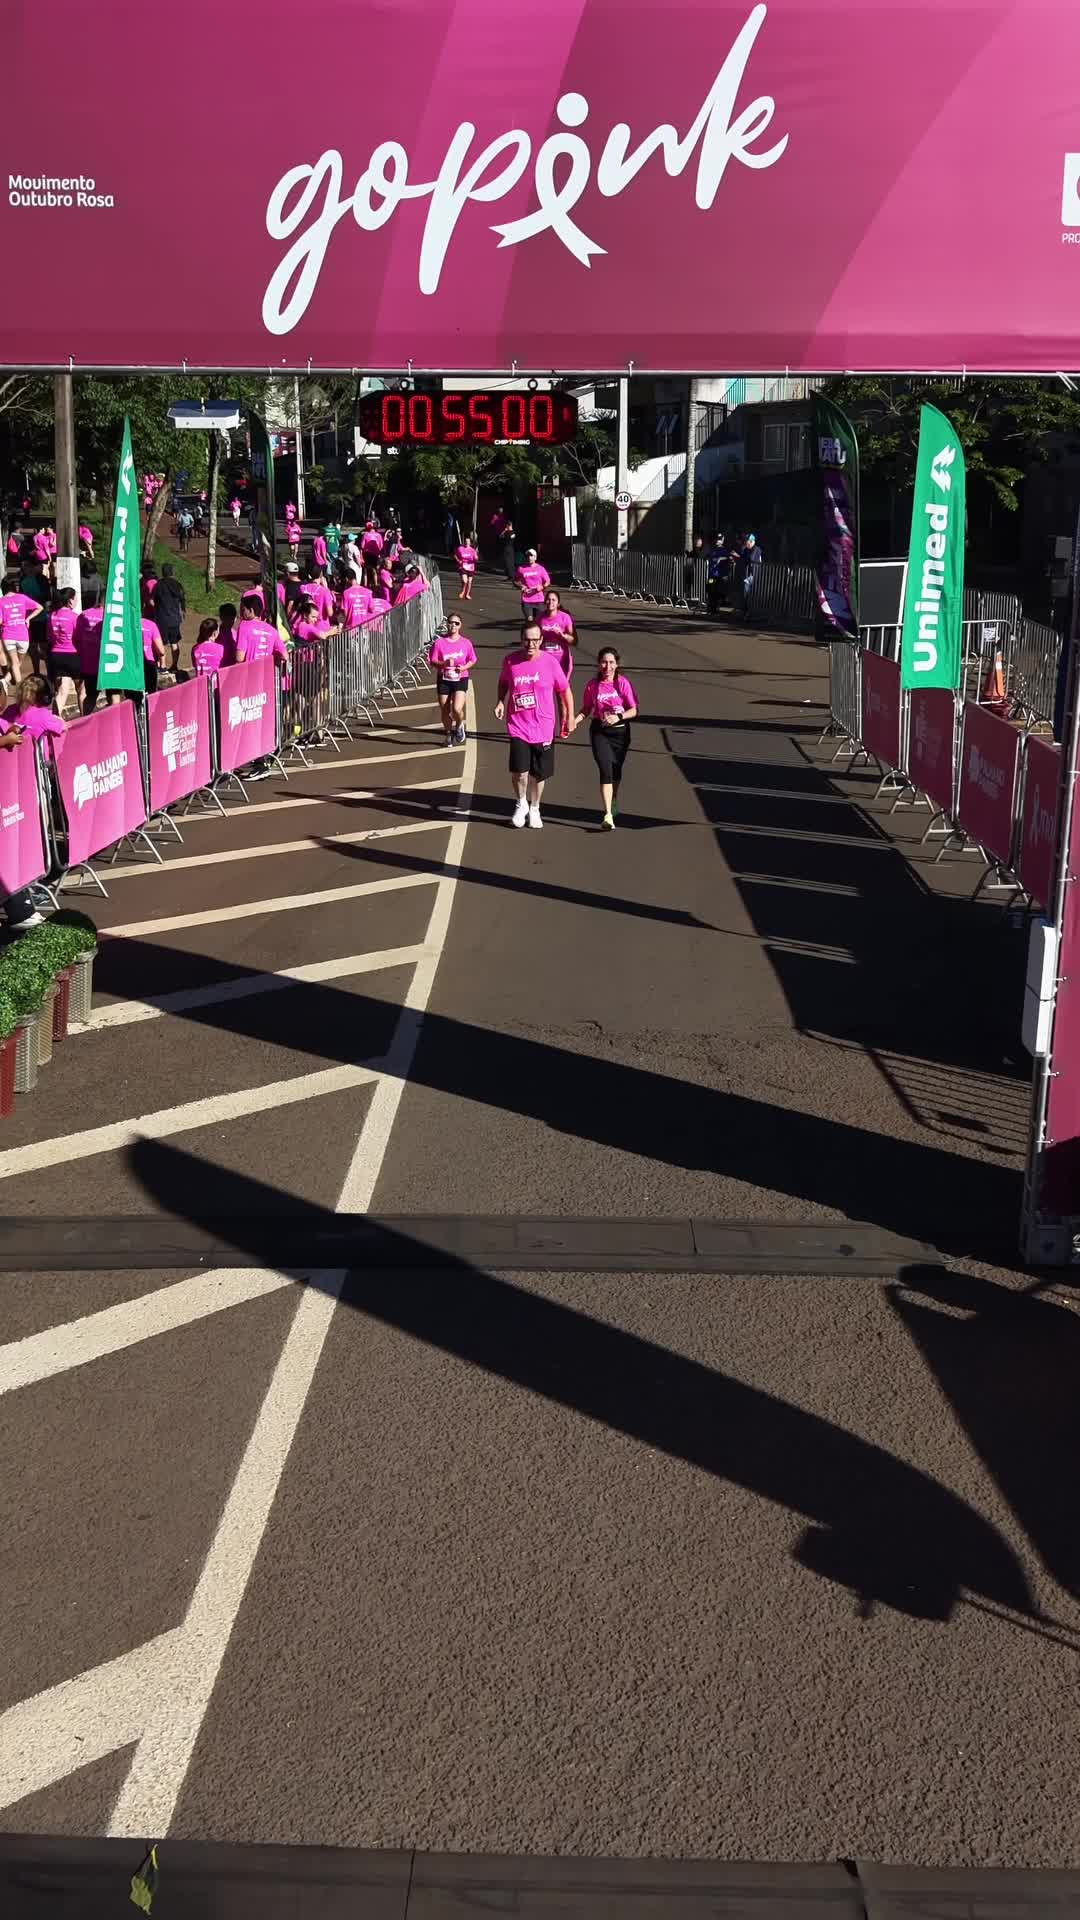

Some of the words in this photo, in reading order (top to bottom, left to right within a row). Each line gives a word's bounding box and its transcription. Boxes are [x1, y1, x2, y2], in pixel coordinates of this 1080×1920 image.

[8, 191, 73, 207] Outubro
[77, 191, 114, 207] Rosa
[617, 495, 629, 503] 40
[913, 503, 948, 672] Unimed
[91, 751, 128, 782] PALHANO
